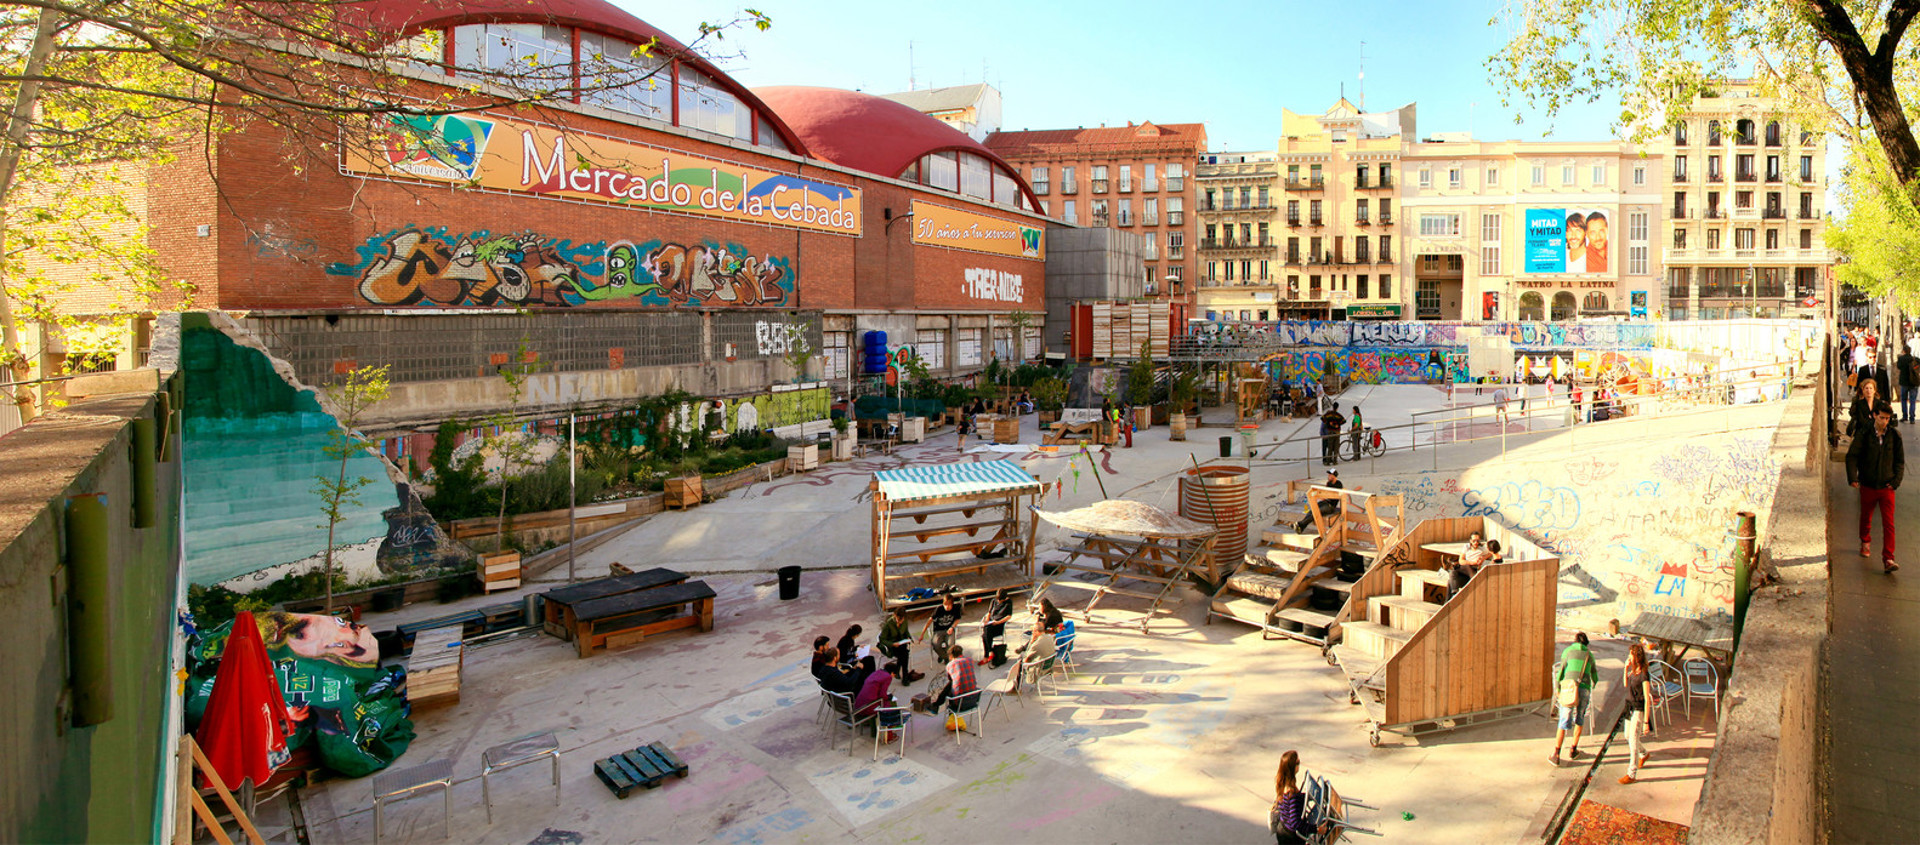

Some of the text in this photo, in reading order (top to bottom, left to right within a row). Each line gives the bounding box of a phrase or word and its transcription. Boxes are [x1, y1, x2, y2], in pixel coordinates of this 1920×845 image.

[521, 129, 855, 229] Mercado de la Cebada
[918, 218, 934, 239] 50
[936, 224, 960, 239] años
[963, 231, 970, 240] a
[985, 225, 1016, 240] servicio
[1530, 227, 1562, 236] Y MITAD
[1531, 219, 1558, 228] MITAD
[1654, 575, 1686, 597] LM
